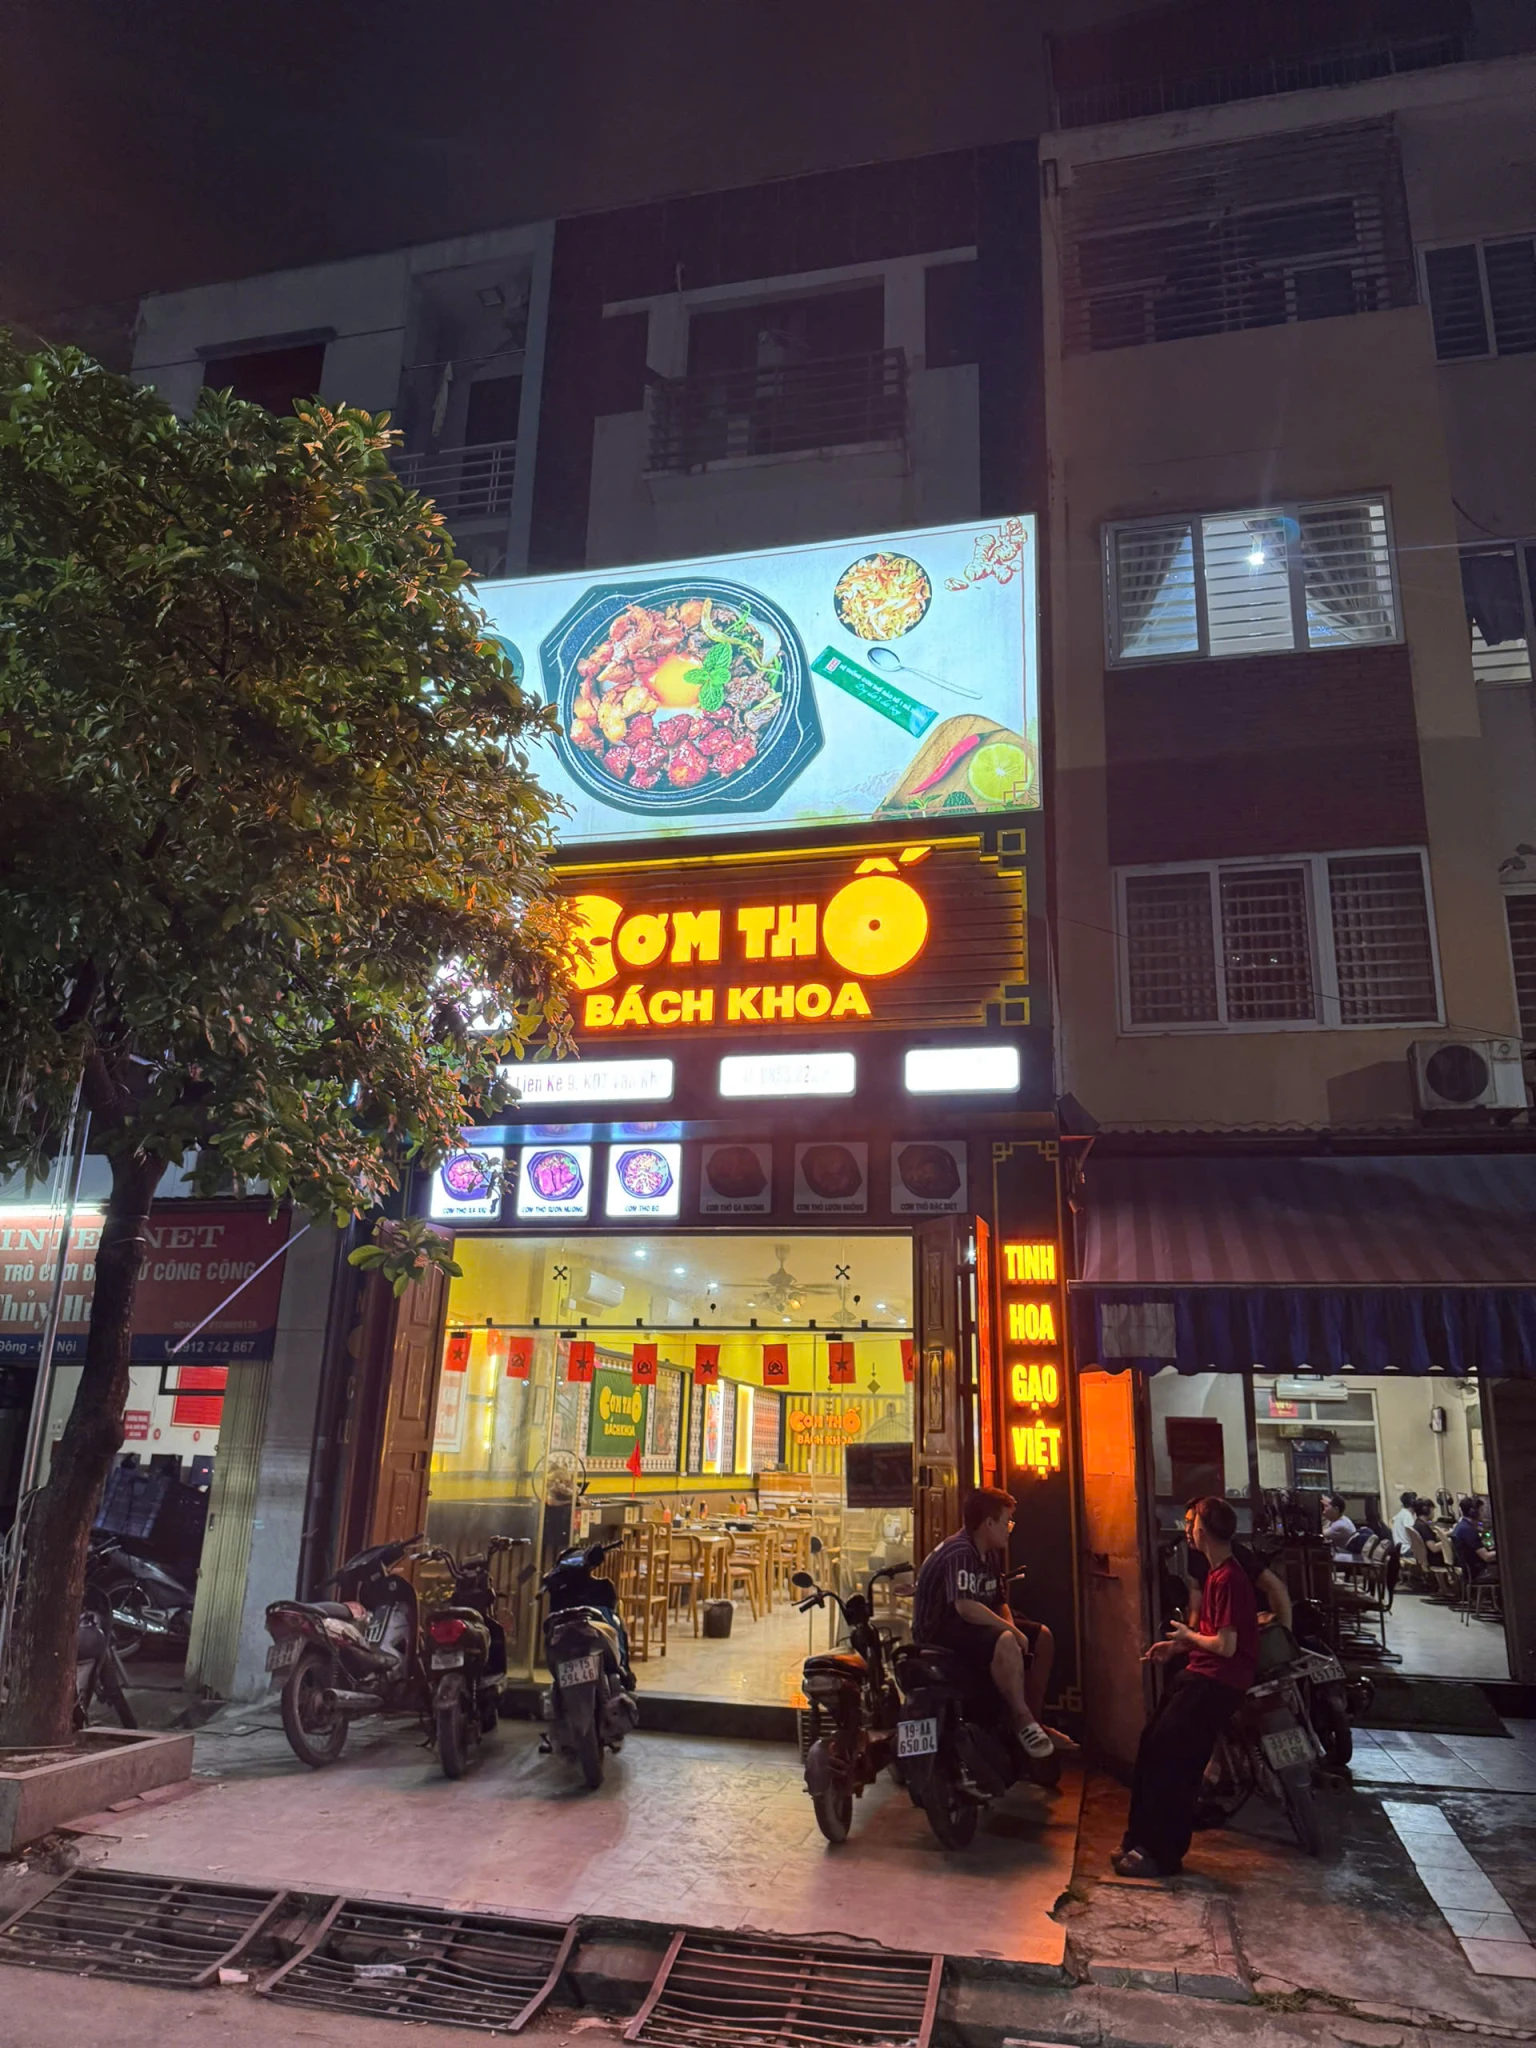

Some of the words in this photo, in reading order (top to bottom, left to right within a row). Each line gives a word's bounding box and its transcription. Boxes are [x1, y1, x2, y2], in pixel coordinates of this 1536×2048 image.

[738, 847, 931, 977] THỐ
[584, 985, 714, 1027] BÁCH
[727, 982, 872, 1020] KHOA
[0, 1225, 224, 1251] INTENET
[4, 1259, 35, 1281] TRÒ
[153, 1259, 200, 1281] CÔNG
[206, 1259, 256, 1284] CỘNG
[1005, 1245, 1056, 1280] TINH
[1009, 1304, 1056, 1341] HOA
[1011, 1364, 1057, 1411] GẠO
[1011, 1419, 1061, 1475] VIỆT
[905, 1721, 931, 1738] 19-AA
